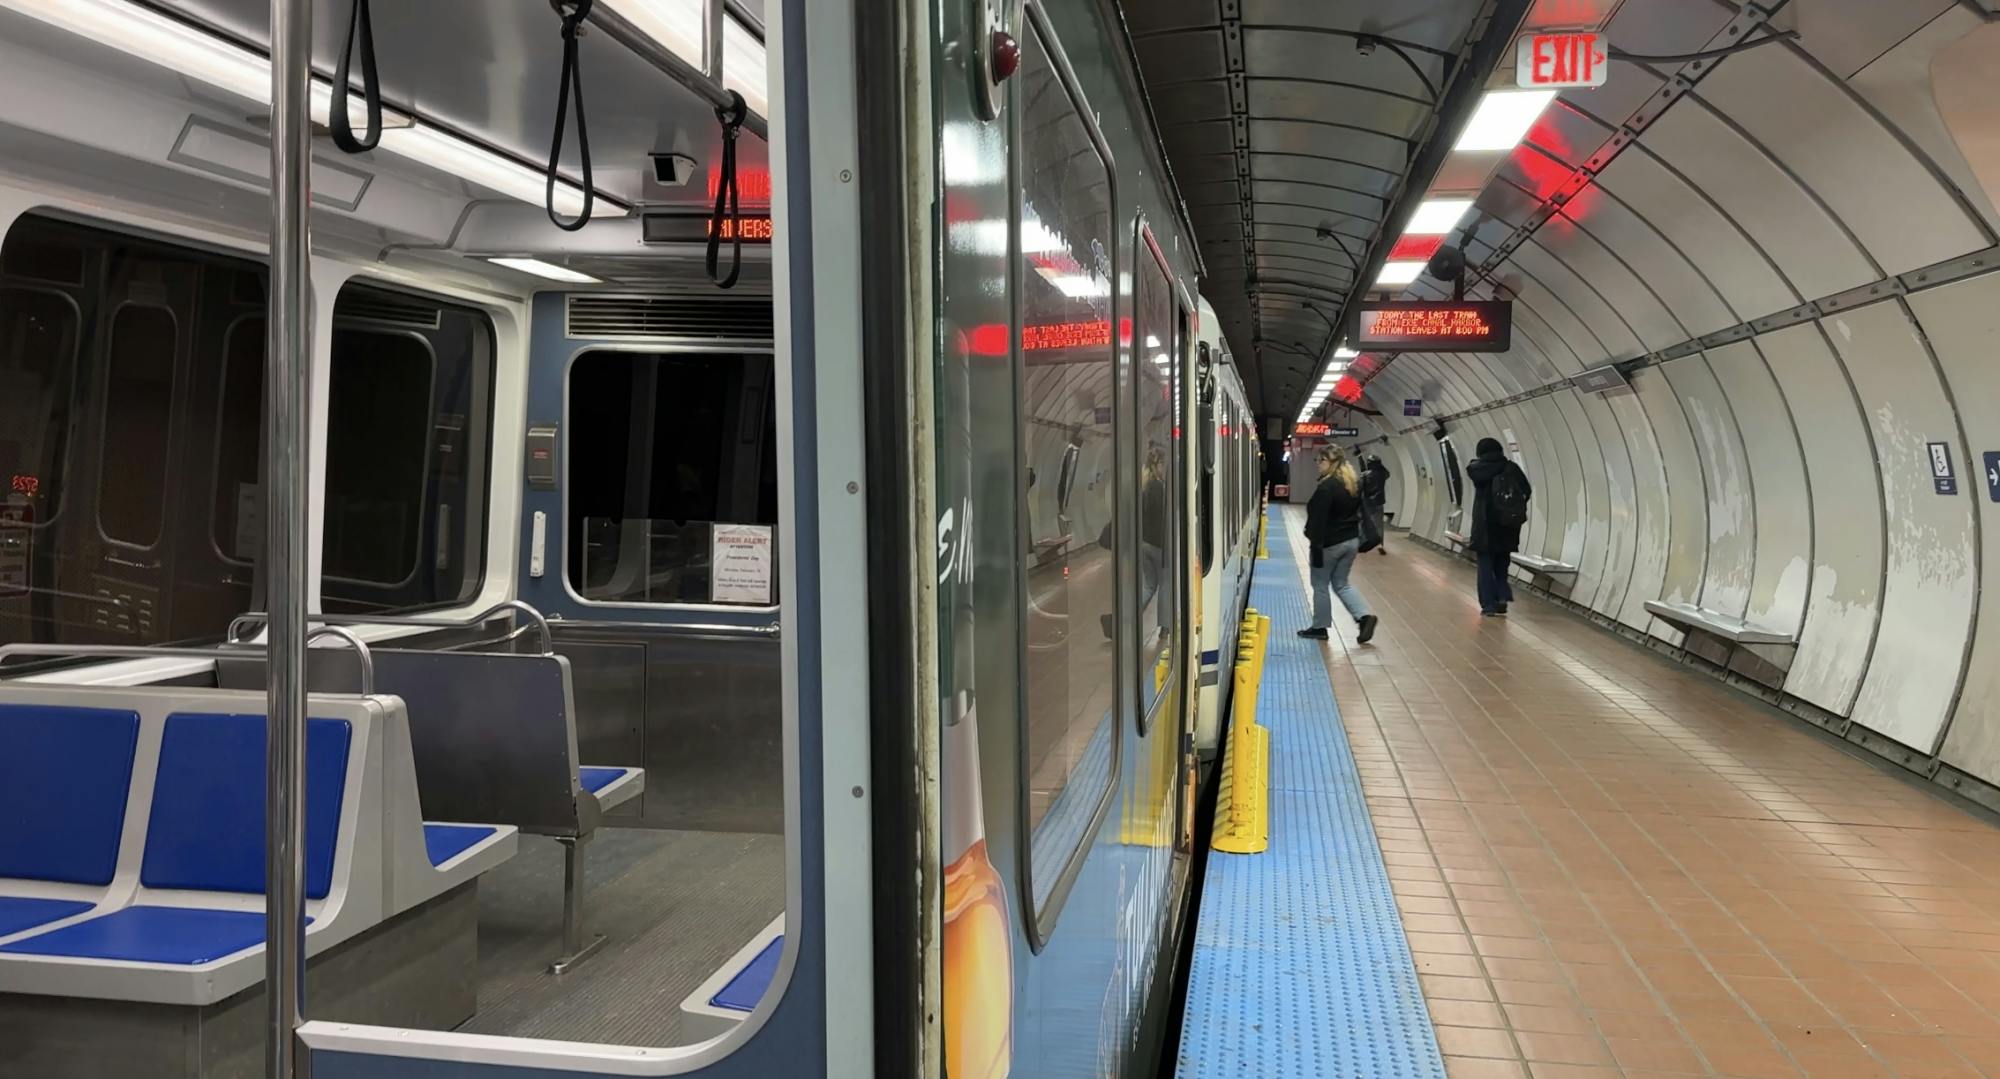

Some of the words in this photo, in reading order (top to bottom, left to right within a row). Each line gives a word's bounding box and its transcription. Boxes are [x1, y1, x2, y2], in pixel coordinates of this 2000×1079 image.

[1532, 34, 1597, 83] EXIT
[1379, 311, 1404, 319] TODAY
[1409, 311, 1424, 319] THE
[1428, 311, 1449, 319] LAST
[1376, 319, 1398, 327] FROM
[1451, 319, 1481, 327] HARBOR
[1370, 326, 1403, 335] STATION
[1406, 326, 1437, 335] LEAVES
[1441, 326, 1451, 335] AT
[1476, 326, 1489, 335] PM
[743, 537, 768, 545] ALERT
